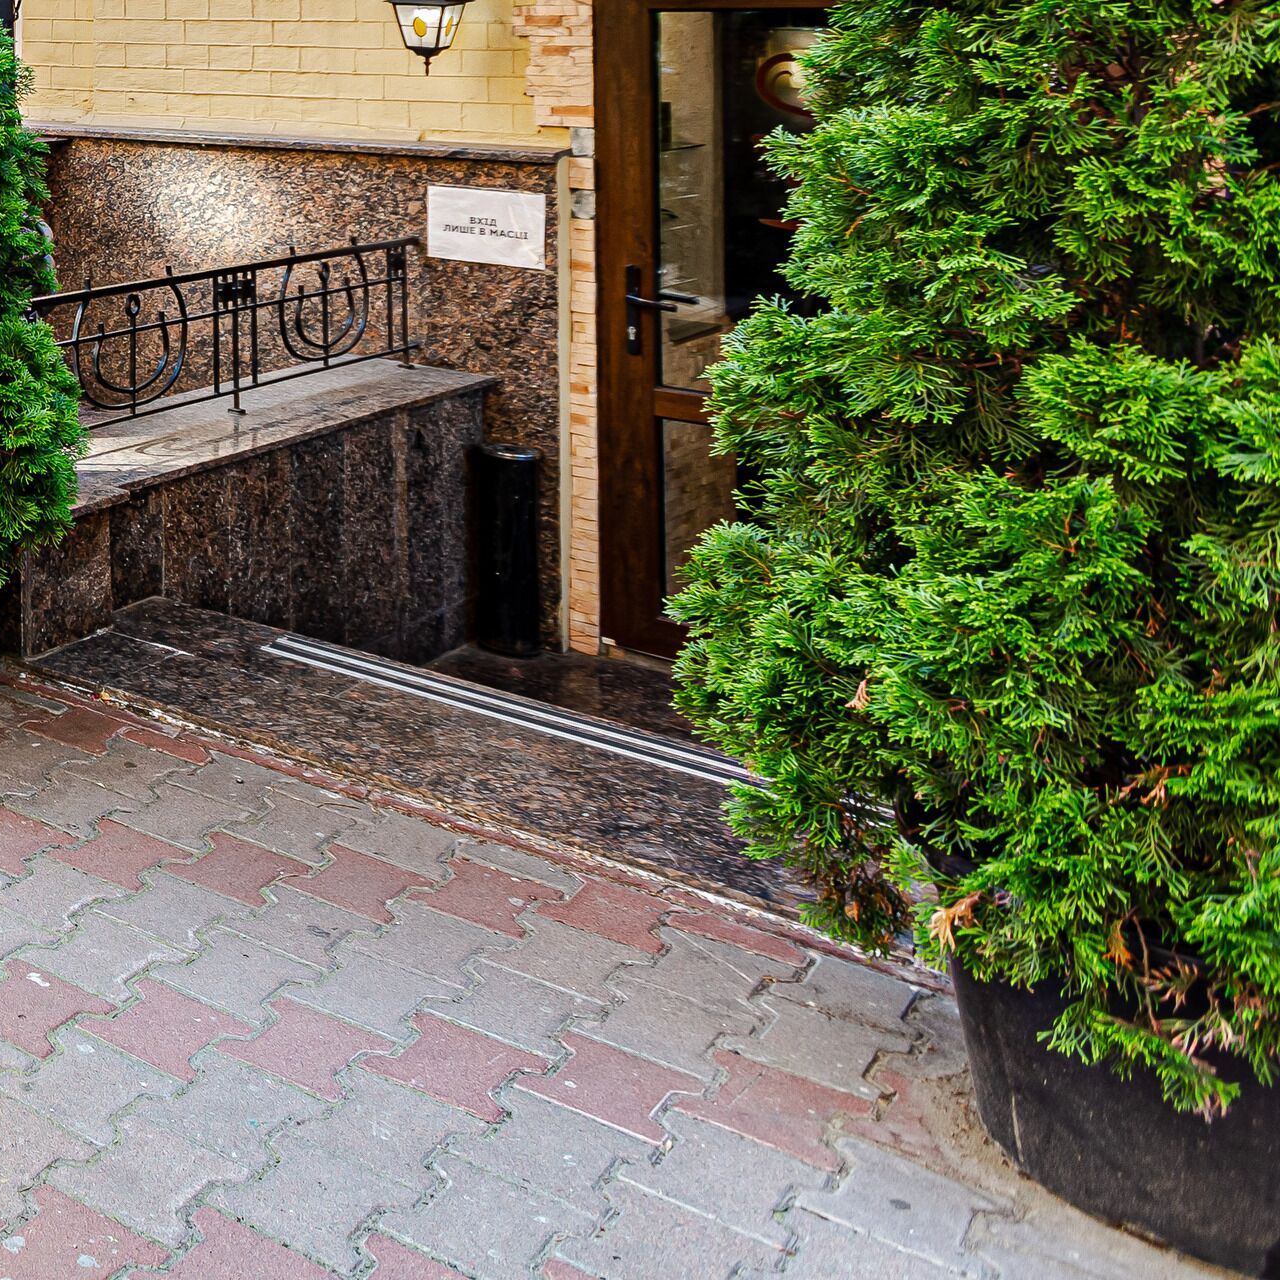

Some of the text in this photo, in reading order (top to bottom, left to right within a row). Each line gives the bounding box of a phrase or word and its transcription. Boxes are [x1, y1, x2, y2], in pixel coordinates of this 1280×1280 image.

[469, 216, 497, 227] ВХІД
[443, 224, 529, 240] ЛИШЕ В МАСЦІ
